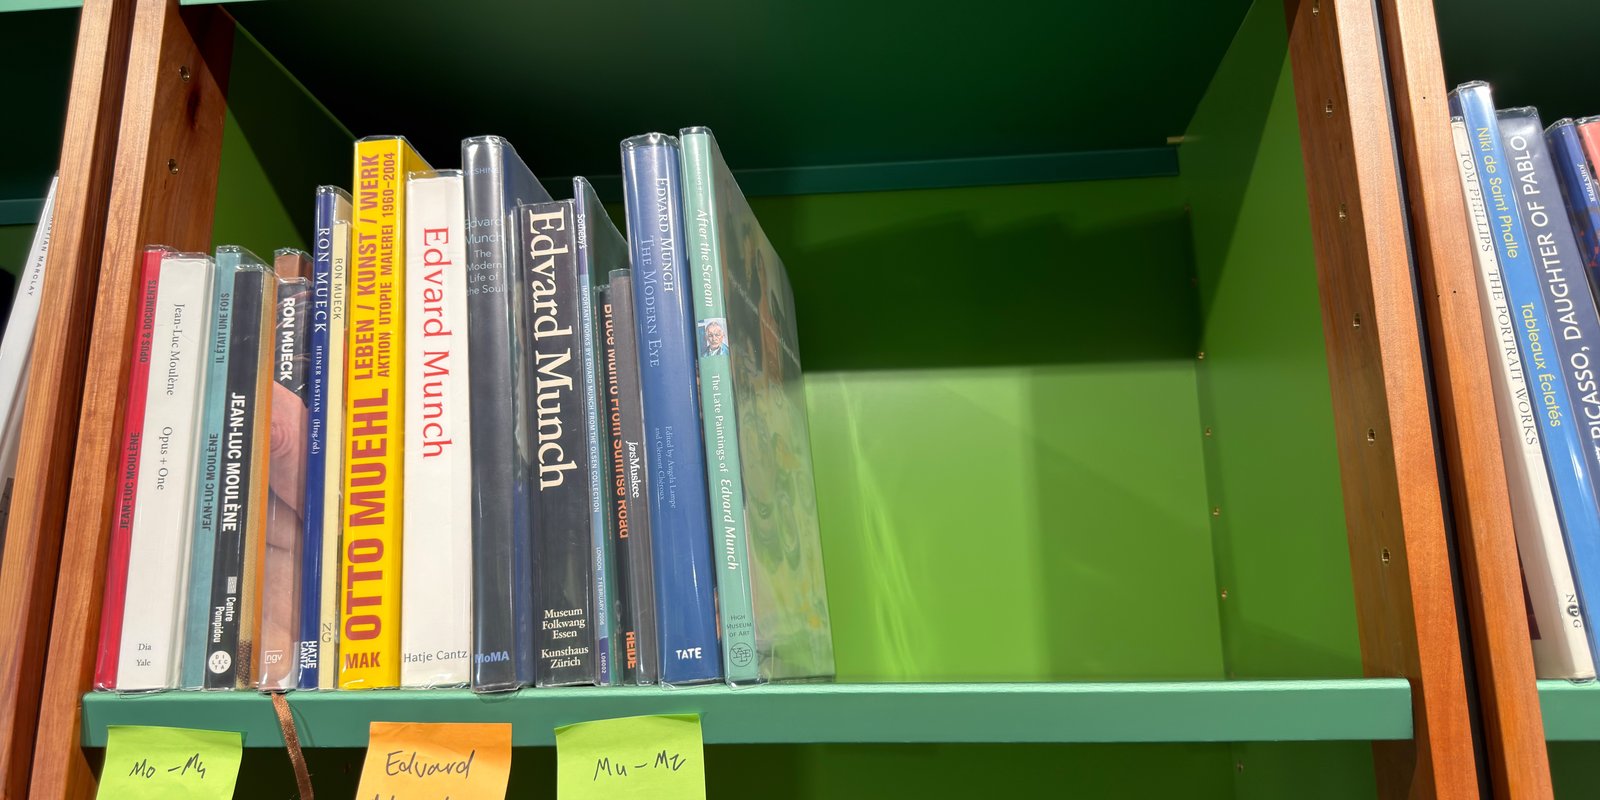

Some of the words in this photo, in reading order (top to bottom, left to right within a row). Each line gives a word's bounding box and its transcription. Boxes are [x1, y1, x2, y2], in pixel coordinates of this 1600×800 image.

[1476, 127, 1493, 152] Niki
[1484, 154, 1497, 174] de
[1510, 135, 1541, 196] PABLO
[360, 154, 380, 210] WERK
[1489, 177, 1509, 212] Saint
[656, 178, 670, 233] EDVARD
[1460, 151, 1477, 182] TOM
[1469, 190, 1493, 252] PHILLIPS
[1527, 201, 1549, 228] OF
[696, 209, 708, 240] After
[1498, 216, 1519, 258] Phalle
[318, 228, 330, 262] RON
[380, 225, 394, 276] MALEREI
[474, 250, 492, 258] The
[640, 235, 655, 266] THE
[700, 240, 712, 262] the
[335, 258, 343, 280] RON
[357, 233, 377, 297] KUNST
[467, 262, 502, 272] Modern
[470, 274, 486, 284] Life
[488, 272, 498, 281] of
[528, 206, 572, 341] Edvard
[661, 238, 674, 292] MUNCH
[423, 227, 453, 338] Edvard
[482, 284, 504, 294] Soul
[702, 262, 714, 308] Scream
[1536, 232, 1582, 341] DAUGHTER
[144, 280, 156, 332] DOCUMENTS
[220, 292, 230, 314] FOIS
[282, 298, 296, 328] RON
[314, 272, 328, 332] MUECK
[333, 282, 342, 320] MUECK
[379, 282, 392, 325] UTOPIE
[582, 285, 590, 322] IMPORTANT
[644, 269, 658, 334] MODERN
[170, 304, 186, 348] Jean-Luc
[218, 315, 229, 331] UNE
[583, 322, 592, 346] WORKS
[140, 340, 150, 363] OPUS
[216, 331, 228, 353] ÉTAIT
[280, 330, 296, 382] MUECK
[354, 320, 374, 380] LEBEN
[378, 332, 391, 378] AKTION
[584, 348, 592, 356] BY
[648, 338, 662, 368] EYE
[216, 354, 224, 364] IL
[584, 358, 592, 384] EDVARD
[1488, 269, 1504, 301] THE
[1496, 304, 1524, 382] PORTRAIT
[1515, 387, 1538, 446] WORKS
[1521, 302, 1546, 370] Tableaux
[1538, 373, 1563, 428] Éclatés
[166, 350, 180, 396] Moulène
[712, 373, 720, 390] The
[423, 350, 453, 459] Munch
[586, 385, 594, 410] MUNCH
[713, 392, 721, 414] Late
[226, 392, 246, 460] JEAN-LUC
[535, 348, 578, 492] Munch
[588, 412, 596, 431] FROM
[158, 426, 172, 456] Opus
[666, 426, 674, 448] Edited
[715, 415, 726, 460] Paintings
[160, 458, 168, 466] +
[207, 432, 218, 478] MOULÈNE
[349, 388, 388, 527] MUEHL
[614, 440, 626, 496] Sunrise
[666, 448, 674, 458] by
[720, 462, 728, 473] of
[120, 480, 134, 530] JEAN-LUC
[127, 432, 140, 474] MOULÈNE
[157, 468, 168, 490] One
[667, 460, 676, 484] Angela
[202, 482, 215, 531] JEAN-LUC
[222, 462, 242, 532] MOULÈNE
[591, 471, 600, 513] COLLECTION
[720, 478, 736, 522] Edvard
[724, 526, 740, 570] Munch
[345, 538, 384, 640] OTTO
[225, 596, 236, 622] Centre
[542, 618, 586, 630] Folkwang
[544, 608, 583, 620] Museum
[213, 606, 225, 643] Pompidou
[552, 630, 578, 640] Essen
[138, 642, 152, 651] Dia
[266, 653, 283, 664] ngv
[300, 641, 308, 670] CANTZ
[307, 640, 318, 669] HATJE
[345, 652, 380, 670] MAK
[404, 652, 433, 664] Hatje
[436, 649, 468, 661] Cantz
[474, 650, 510, 664] MoMA
[541, 646, 589, 659] Kunsthaus
[676, 646, 702, 660] TATE
[136, 659, 151, 667] Yale
[550, 657, 581, 670] Zürich
[129, 758, 156, 778] Mo
[386, 750, 476, 779] Edvard
[594, 757, 628, 781] Mu
[654, 750, 687, 772] Mz
